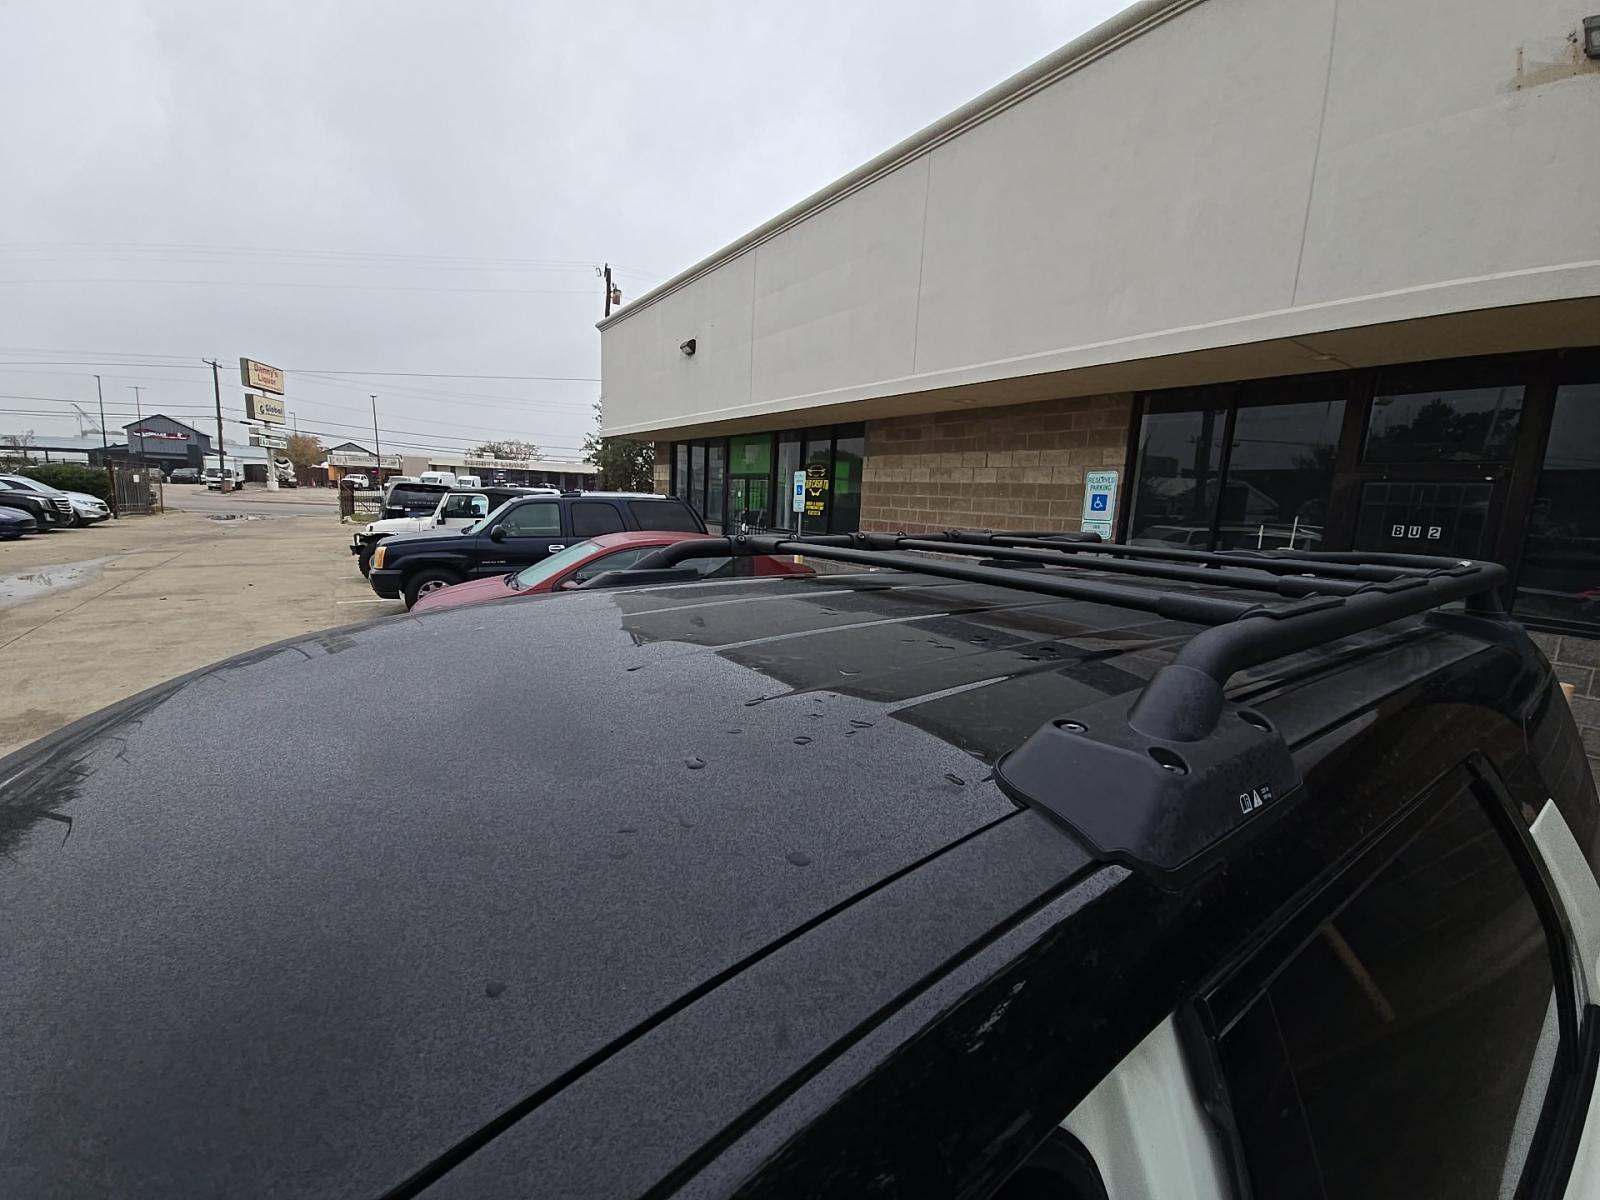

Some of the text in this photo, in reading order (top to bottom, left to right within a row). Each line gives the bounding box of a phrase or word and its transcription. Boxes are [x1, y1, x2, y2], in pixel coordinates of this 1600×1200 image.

[258, 374, 276, 384] Liquor
[265, 404, 283, 414] Global
[1088, 476, 1115, 484] RESERVED
[1089, 484, 1112, 492] PARKING
